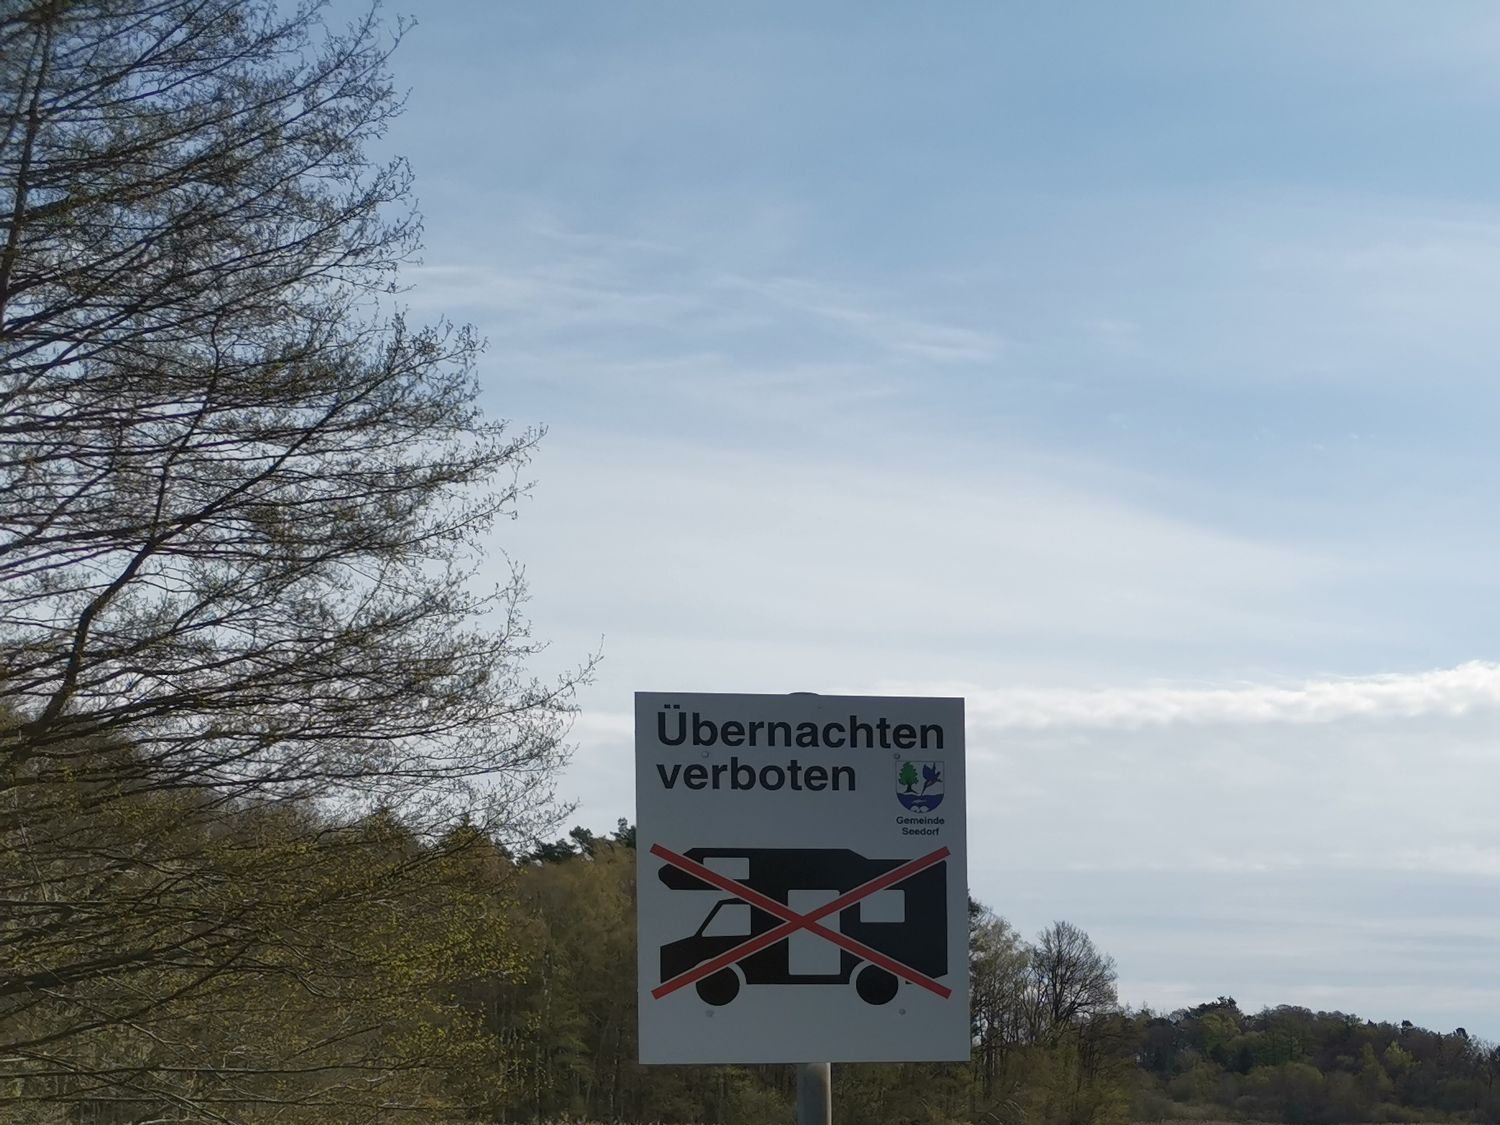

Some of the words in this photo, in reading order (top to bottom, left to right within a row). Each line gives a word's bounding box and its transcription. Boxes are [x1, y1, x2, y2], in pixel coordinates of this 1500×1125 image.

[657, 703, 944, 749] Übernachten
[656, 757, 856, 791] verboten
[896, 816, 945, 825] Gemeinde
[902, 827, 939, 836] Seedorf
